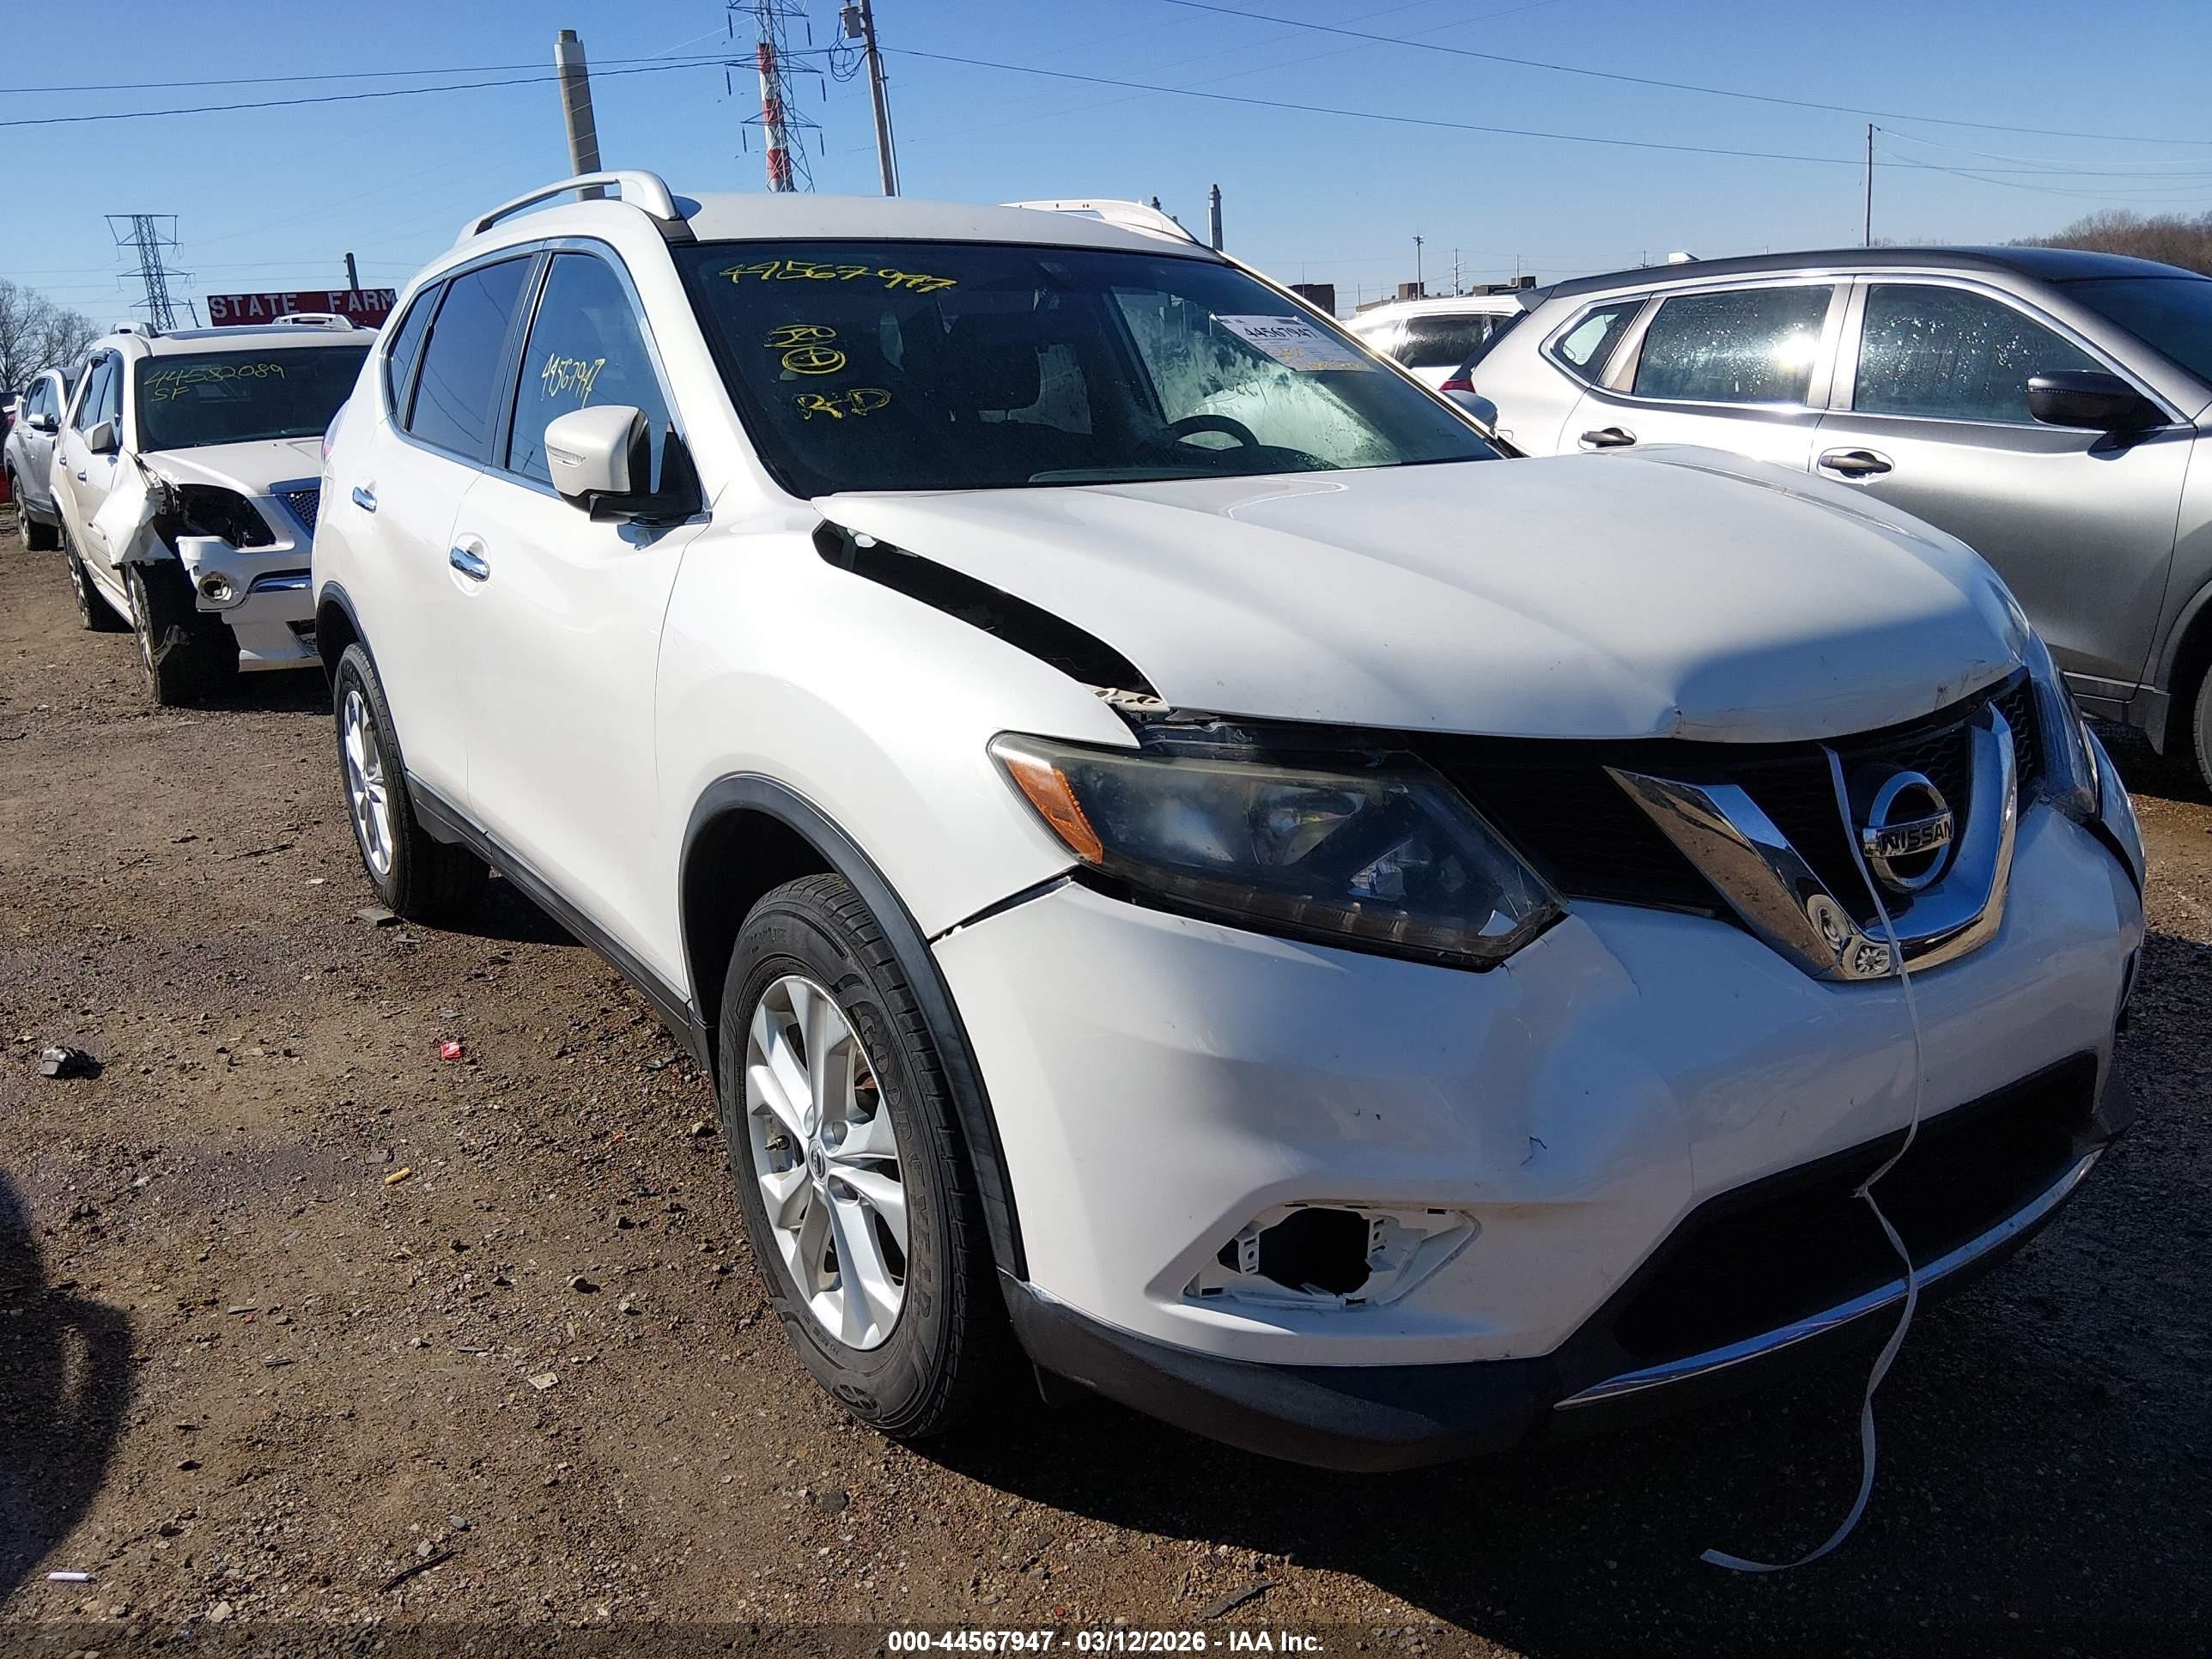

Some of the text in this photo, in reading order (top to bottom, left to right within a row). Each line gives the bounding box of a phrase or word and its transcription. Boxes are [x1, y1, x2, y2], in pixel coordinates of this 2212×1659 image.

[210, 289, 397, 319] STATE FARM
[1243, 326, 1319, 338] 44567947
[144, 363, 285, 388] 44582089
[151, 386, 190, 402] SF
[1880, 818, 1954, 851] NISSAN
